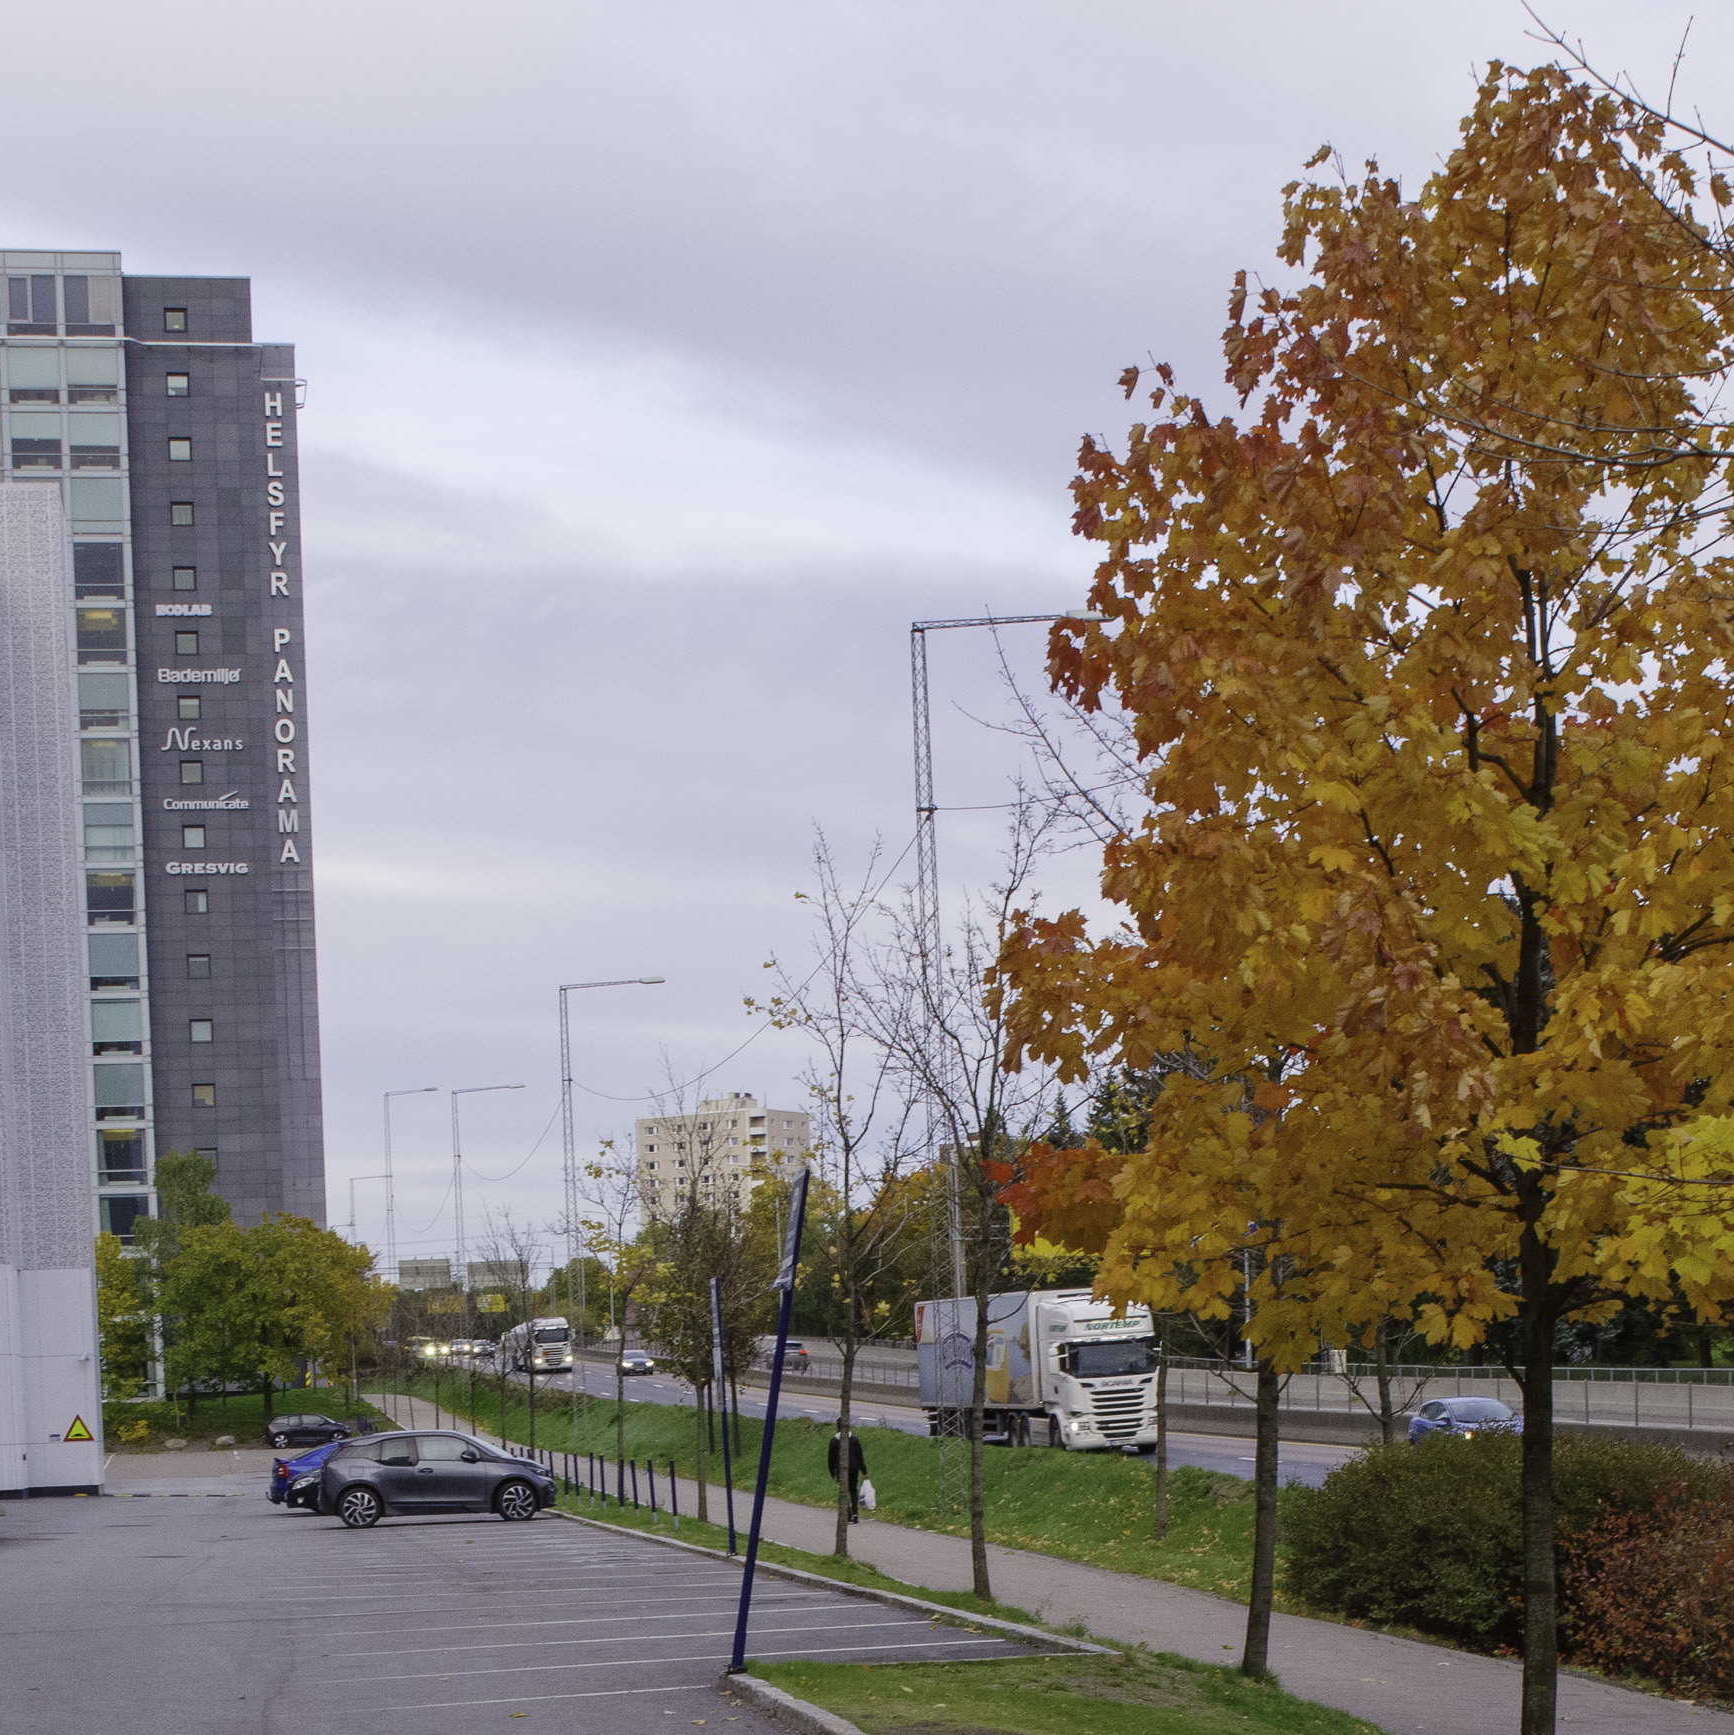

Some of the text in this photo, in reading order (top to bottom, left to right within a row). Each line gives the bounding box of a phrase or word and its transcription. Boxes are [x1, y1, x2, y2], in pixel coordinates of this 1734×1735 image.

[264, 391, 300, 863] HELSFYR PANORAMA
[157, 668, 242, 685] Bademiljø
[161, 727, 243, 751] Nexans
[163, 790, 249, 810] Communicate
[165, 862, 249, 875] GRESVIG
[1084, 1320, 1140, 1331] NORTEMP
[1101, 1379, 1133, 1387] SCANIA
